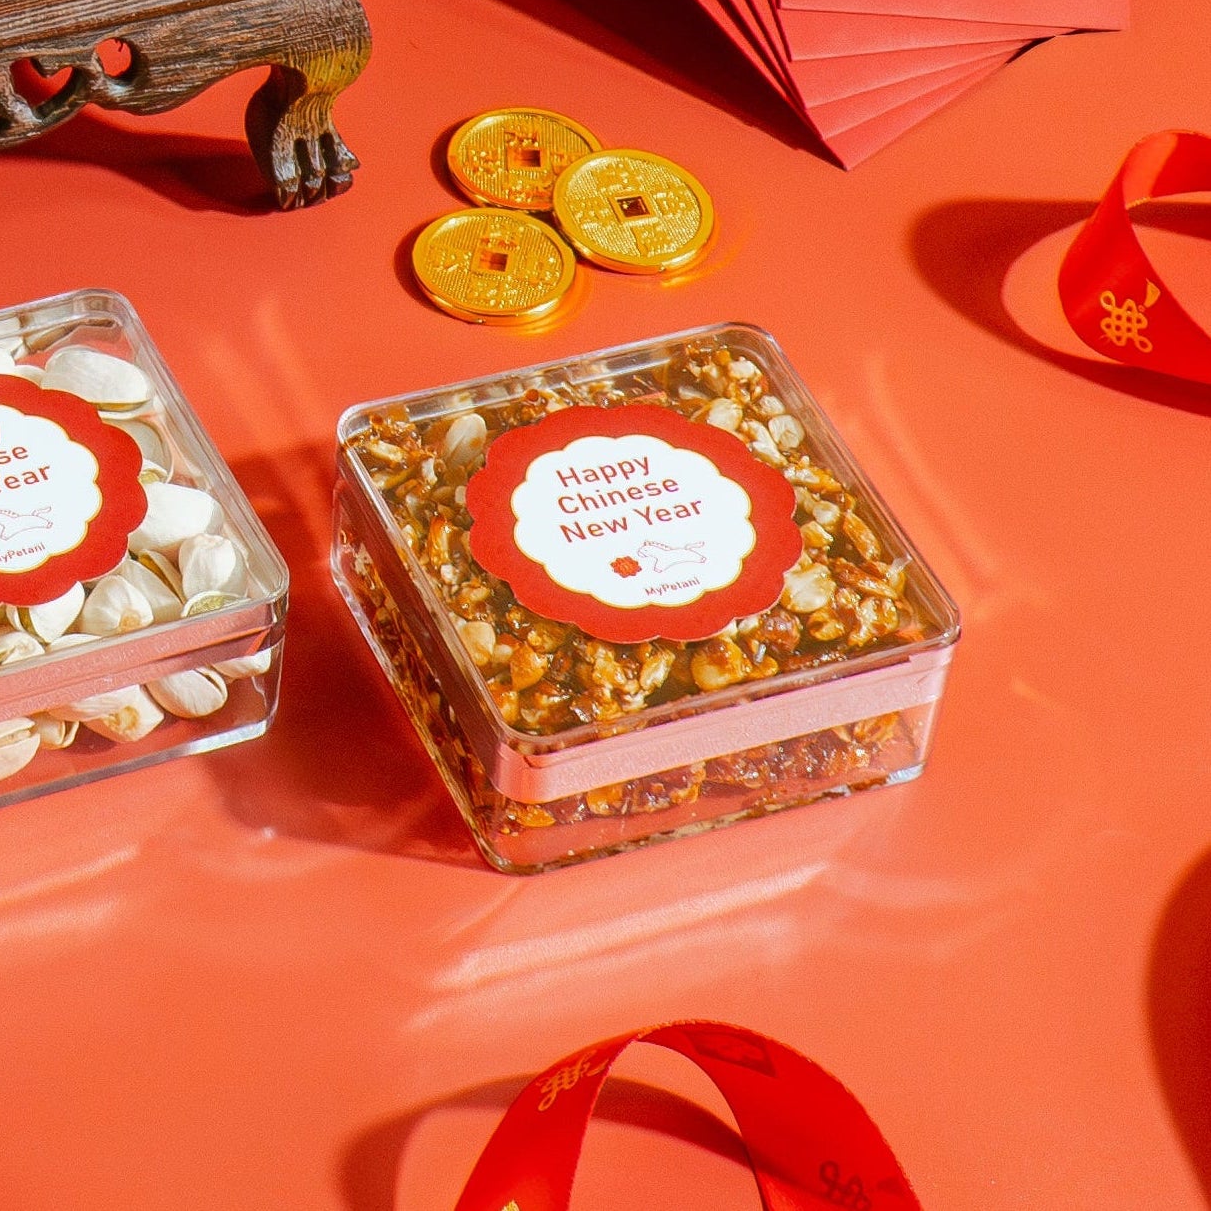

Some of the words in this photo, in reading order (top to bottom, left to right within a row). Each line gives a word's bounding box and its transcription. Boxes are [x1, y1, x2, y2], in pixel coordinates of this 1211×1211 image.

[556, 456, 650, 488] Happy
[557, 478, 680, 514] Chinese
[559, 516, 629, 543] New
[632, 499, 702, 526] Year
[644, 577, 701, 597] MyPetani
